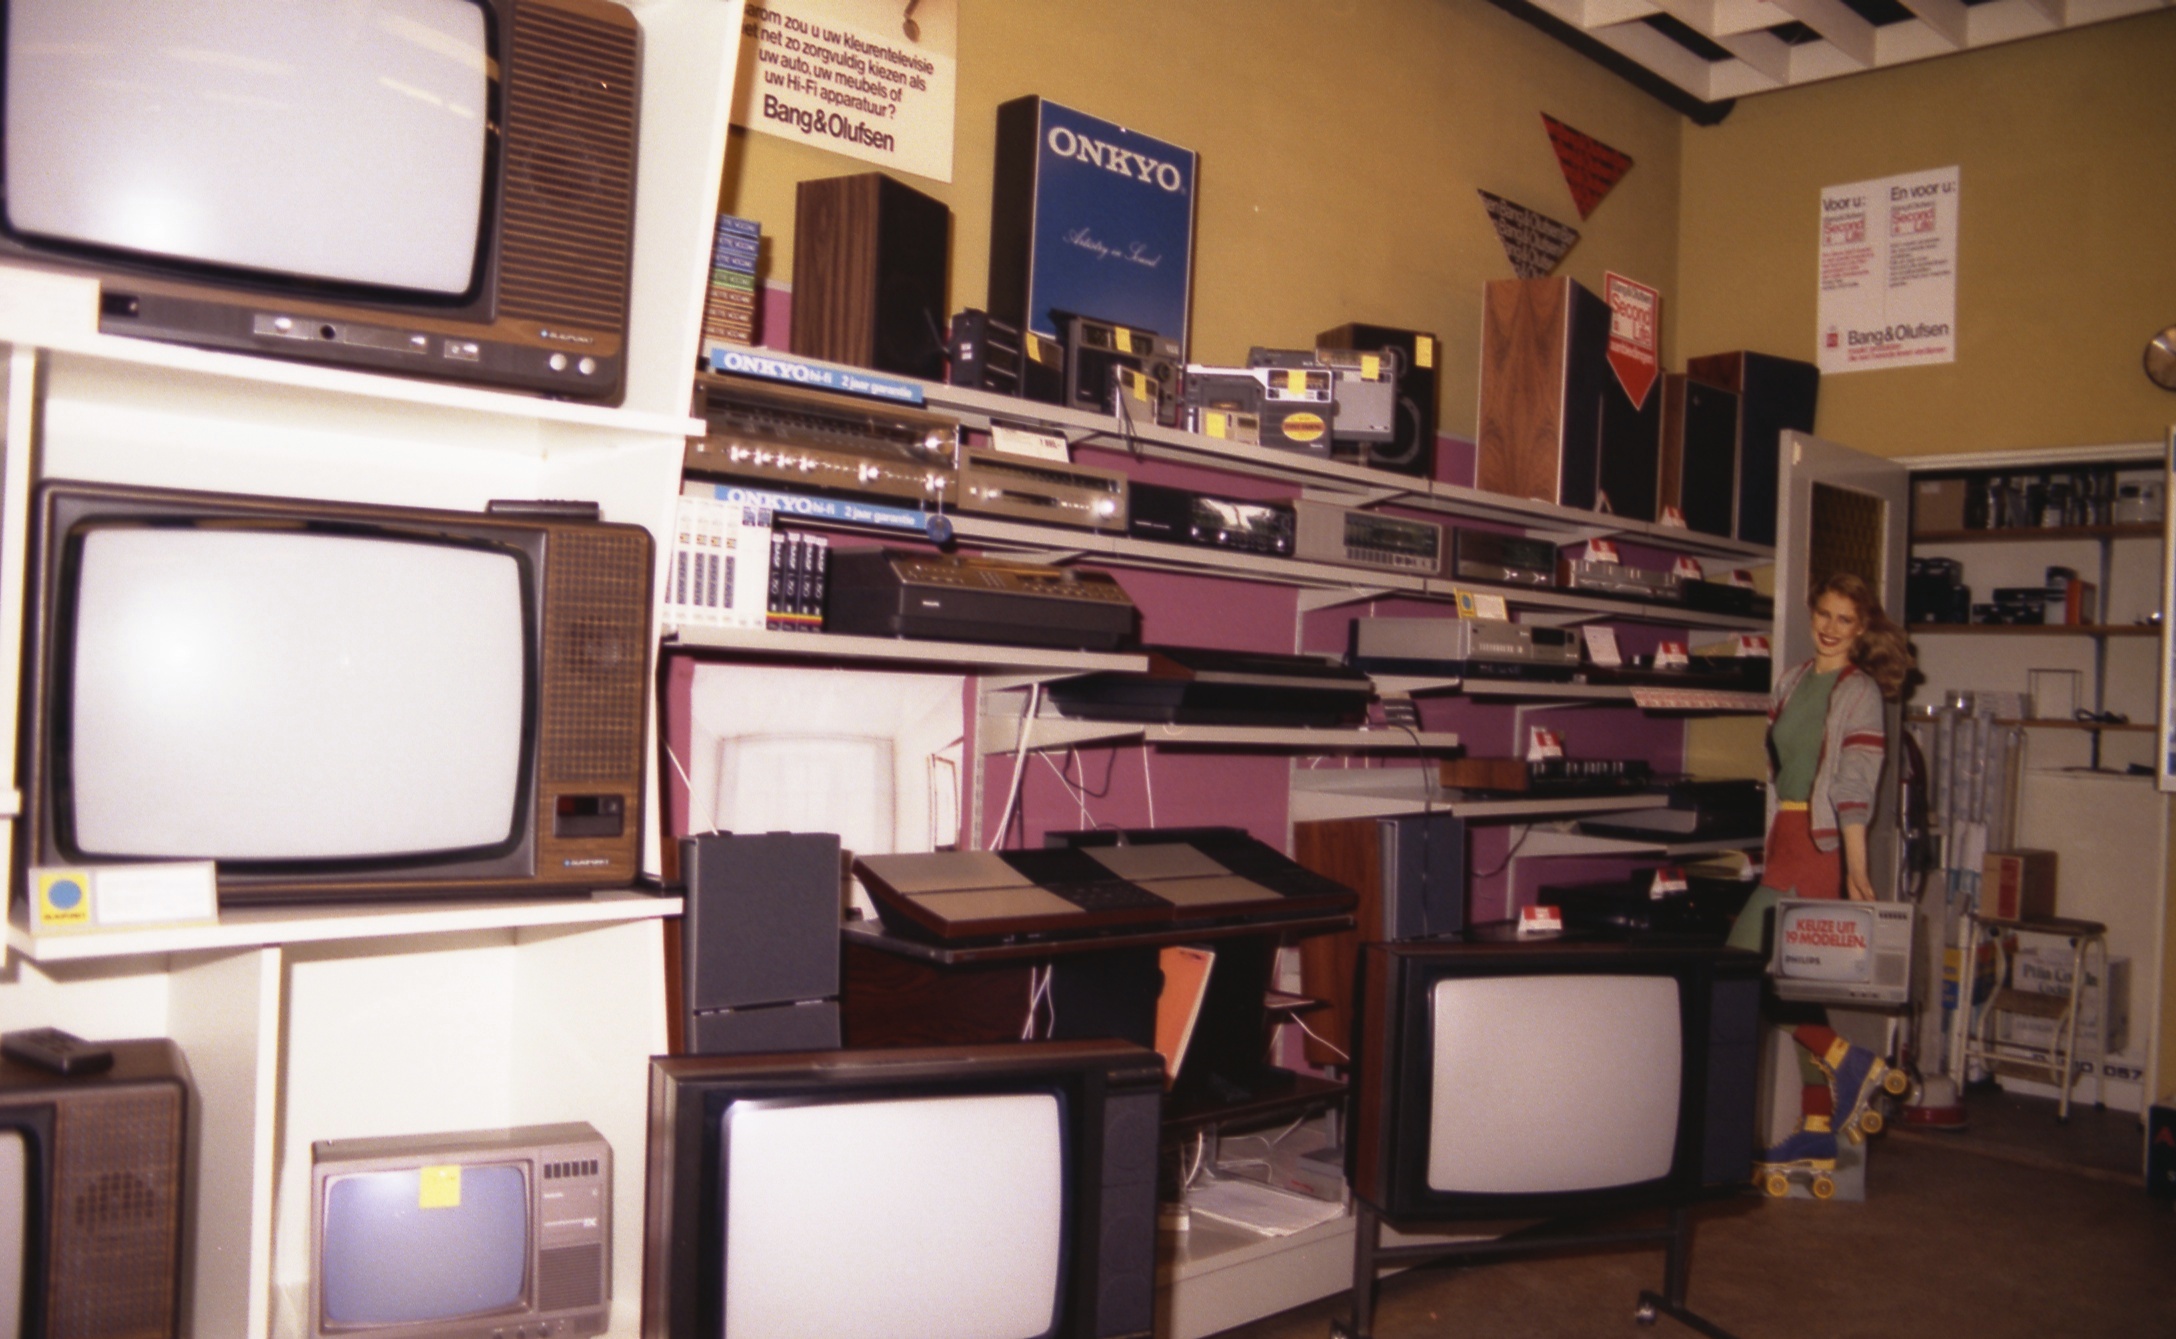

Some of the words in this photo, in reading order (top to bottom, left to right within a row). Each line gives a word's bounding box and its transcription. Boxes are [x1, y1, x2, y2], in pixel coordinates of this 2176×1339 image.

[745, 4, 782, 26] arom
[784, 16, 808, 34] zou
[811, 25, 820, 37] u
[823, 29, 841, 44] uw
[844, 33, 935, 75] kleurentelevisie
[743, 23, 759, 40] et
[760, 27, 782, 46] net
[785, 36, 801, 51] zo
[802, 40, 865, 74] zorgvuldig
[868, 62, 907, 85] kiezen
[909, 74, 927, 92] als
[759, 49, 779, 64] uw
[814, 66, 832, 81] uw
[835, 71, 887, 96] meubels
[890, 87, 902, 102] of
[765, 69, 784, 86] uw
[787, 72, 818, 96] Hi-Fi
[763, 93, 895, 151] Bang&Olufsen
[1048, 126, 1181, 192] ONKYO
[1823, 197, 1849, 211] Voor
[1891, 186, 1908, 201] En
[1910, 184, 1939, 198] voor
[724, 352, 809, 382] ONKYO
[841, 375, 850, 387] 2
[727, 489, 812, 514] ONKYO
[844, 506, 853, 518] 2
[1785, 930, 1799, 944] 19
[1796, 918, 1834, 933] KEUZE
[1836, 921, 1857, 934] UIT
[1785, 955, 1821, 966] PHILIPS
